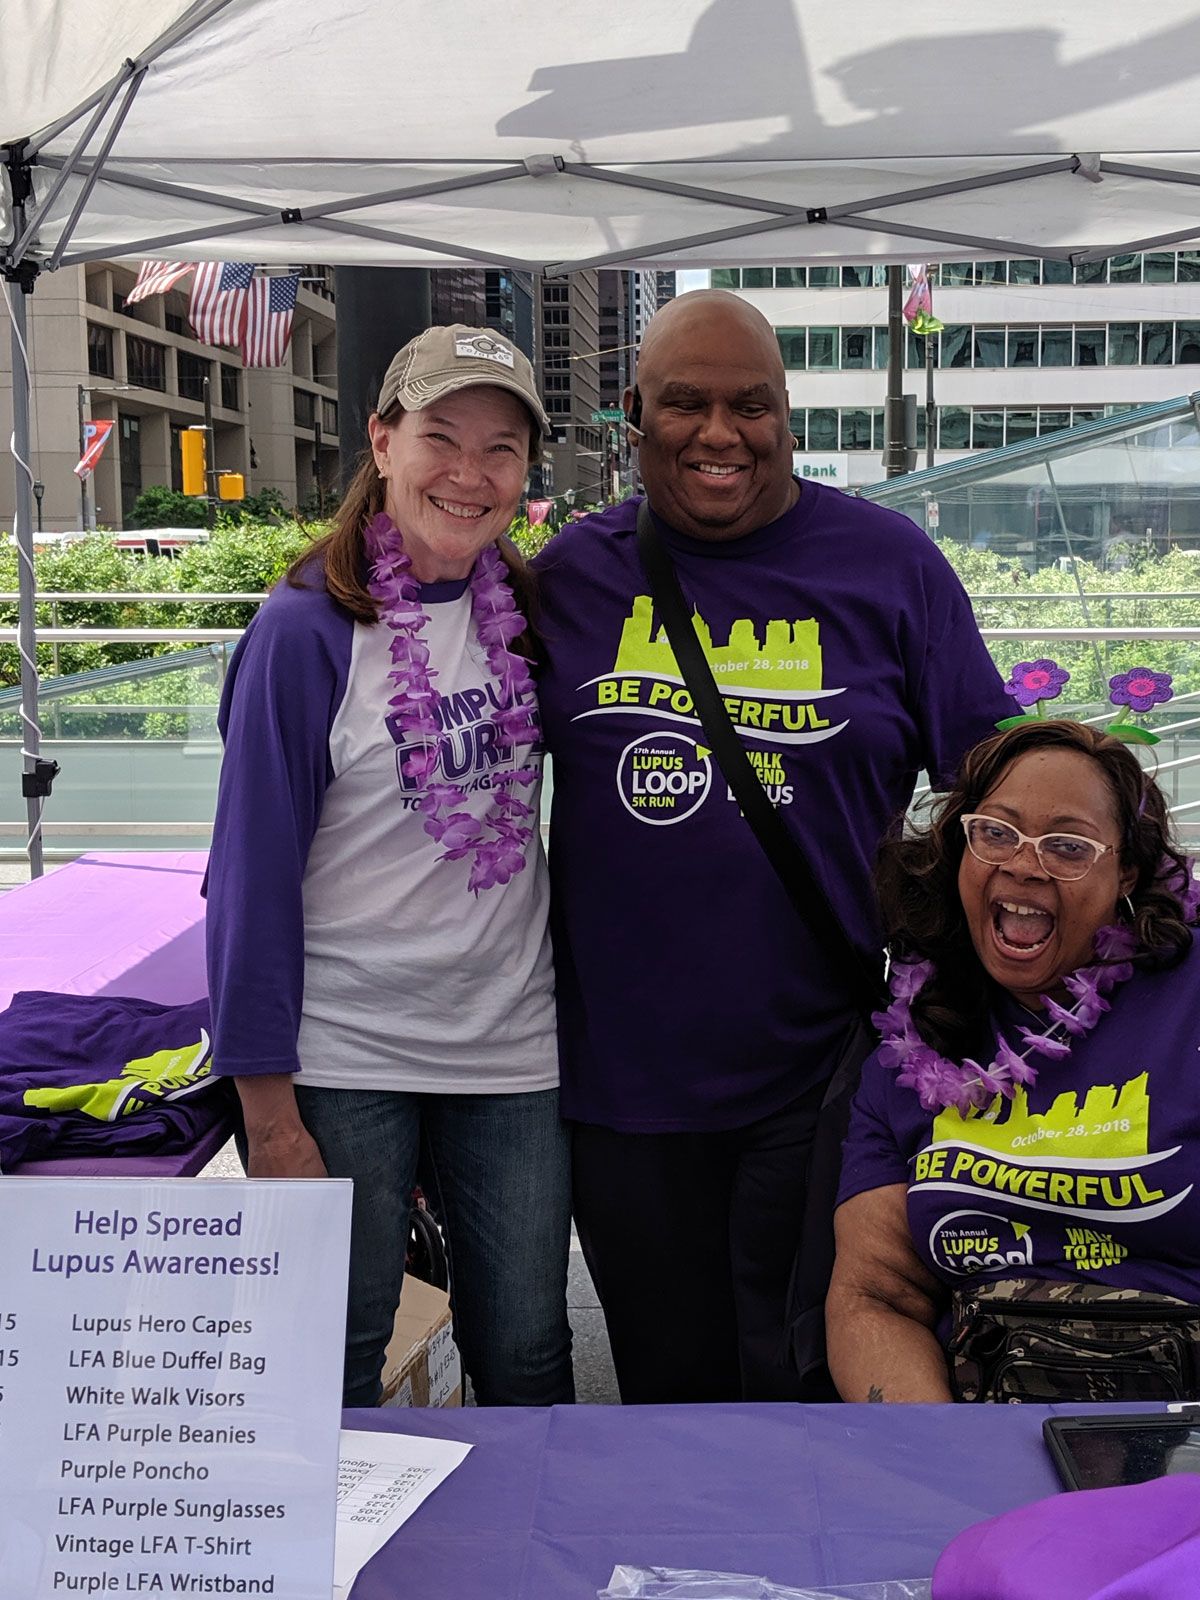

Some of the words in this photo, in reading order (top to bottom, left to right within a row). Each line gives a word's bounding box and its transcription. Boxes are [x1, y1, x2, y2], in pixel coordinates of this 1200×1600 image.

[803, 464, 837, 477] Bank
[713, 660, 750, 673] tober
[753, 659, 775, 671] 28,
[777, 659, 809, 670] 2018
[598, 680, 641, 705] BE
[648, 683, 830, 731] POERFUL
[633, 756, 683, 770] LUPUS
[632, 771, 706, 794] LOOP
[632, 797, 647, 807] 5K
[649, 797, 675, 807] RUN
[727, 785, 794, 805] LUS
[1011, 1127, 1063, 1149] October
[1065, 1124, 1089, 1138] 28,
[1092, 1118, 1131, 1136] 2018
[915, 1151, 948, 1181] BE
[950, 1151, 1164, 1207] POWERFUL
[75, 1210, 137, 1240] Help
[146, 1211, 242, 1241] Spread
[960, 1228, 988, 1237] Annual
[942, 1237, 999, 1255] LUPUS
[1063, 1244, 1087, 1260] TO
[1090, 1242, 1128, 1259] END
[33, 1249, 114, 1279] Lupus
[123, 1250, 280, 1275] Awareness!
[72, 1314, 131, 1337] Lupus
[139, 1315, 186, 1333] Hero
[192, 1315, 252, 1338] Capes
[69, 1350, 105, 1368] LFA
[113, 1350, 156, 1369] Blue
[163, 1351, 222, 1369] Duffel
[230, 1352, 266, 1375] Bag
[66, 1386, 124, 1405] White
[132, 1387, 181, 1406] Walk
[186, 1388, 245, 1407] Visors
[64, 1423, 100, 1441] LFA
[108, 1424, 172, 1447] Purple
[179, 1425, 256, 1444] Beanies
[61, 1460, 126, 1484] Purple
[133, 1461, 209, 1480] Poncho
[58, 1497, 95, 1515] LFA
[103, 1498, 168, 1521] Purple
[174, 1499, 286, 1523] Sunglasses
[56, 1534, 133, 1558] Vintage
[141, 1536, 178, 1554] LFA
[184, 1536, 252, 1556] T-Shirt
[54, 1571, 119, 1595] Purple
[127, 1573, 163, 1591] LFA
[170, 1573, 275, 1593] Wristband
